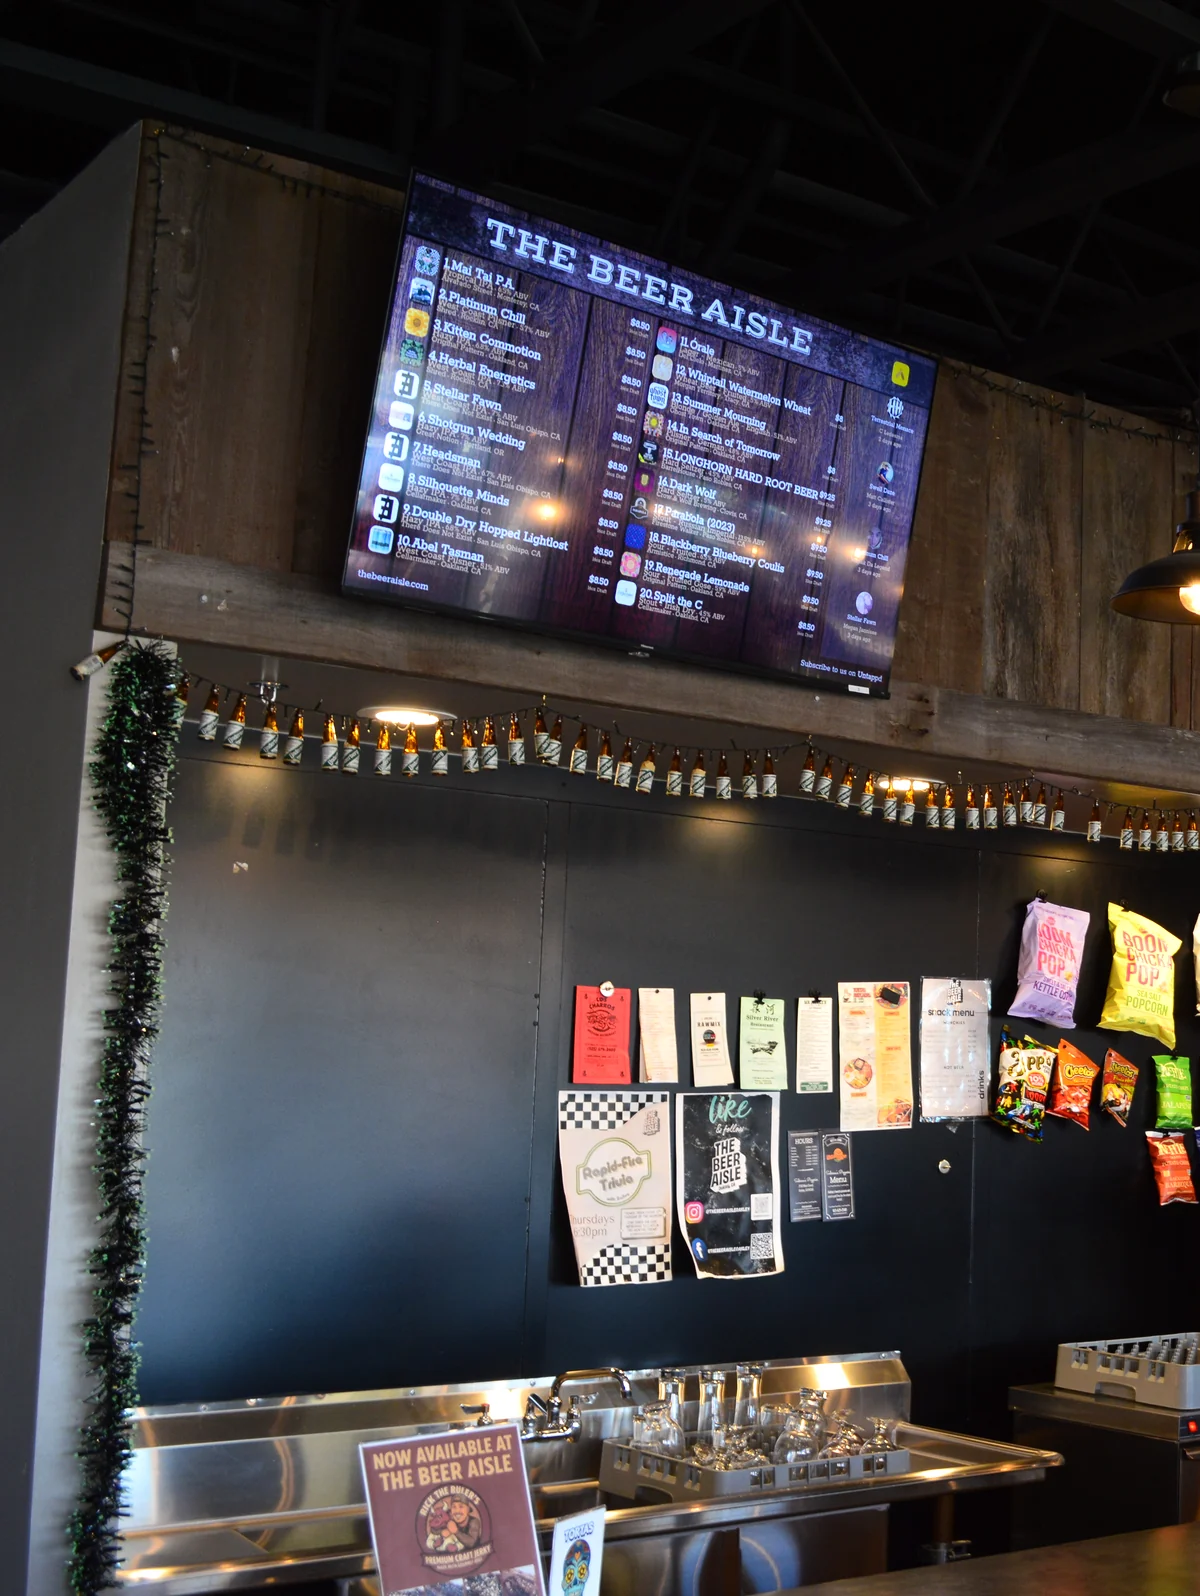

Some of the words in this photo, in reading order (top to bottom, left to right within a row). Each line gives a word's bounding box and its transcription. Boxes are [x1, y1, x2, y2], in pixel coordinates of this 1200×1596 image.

[475, 268, 491, 281] Tai
[486, 217, 576, 273] THE
[588, 254, 694, 313] BEER
[703, 295, 811, 353] AISLE
[501, 308, 525, 324] Chill
[630, 318, 649, 331] $8.50
[480, 333, 541, 360] Commotion
[477, 364, 535, 391] Energetics
[621, 375, 640, 387] $8.50
[472, 394, 501, 411] Fawn
[729, 381, 780, 405] Watermelon
[783, 398, 810, 414] Wheat
[724, 408, 765, 429] Mourning
[835, 414, 843, 422] $8
[477, 426, 525, 452] Wedding
[612, 432, 631, 444] $8.50
[691, 427, 721, 443] Search
[724, 436, 733, 447] of
[734, 440, 780, 460] Tomorrow
[827, 466, 835, 474] $8
[697, 486, 715, 499] Wolf
[735, 468, 762, 483] HARD
[765, 477, 791, 492] ROOT
[794, 485, 818, 499] BEER
[476, 489, 509, 506] Minds
[603, 489, 622, 501] $8.50
[423, 526, 439, 534] Does
[707, 517, 735, 533] (2023)
[454, 516, 475, 532] Dry
[478, 521, 520, 542] Hopped
[523, 531, 568, 553] Lightlost
[441, 544, 484, 562] Tasman
[593, 546, 613, 558] $8.50
[810, 543, 826, 553] $9.50
[712, 547, 755, 567] Blueberry
[758, 559, 784, 573] Coulis
[357, 568, 428, 591] thebeeraisle.com
[471, 567, 481, 575] CA
[806, 569, 822, 579] $9.50
[703, 574, 749, 592] Lemonade
[678, 596, 692, 607] the
[803, 595, 818, 605] $9.50
[798, 621, 814, 631] $8.50
[800, 659, 829, 671] Subscribe
[857, 671, 881, 683] Untappd
[1038, 938, 1077, 964] CHICKA
[1127, 947, 1173, 970] CHICKA
[1037, 950, 1066, 977] POP
[1125, 962, 1160, 987] POP
[1033, 980, 1058, 997] KETTLE
[1136, 989, 1149, 998] SEA
[1149, 993, 1161, 1001] SALT
[588, 1002, 616, 1011] CHARROS
[927, 1007, 951, 1017] snack
[951, 1009, 975, 1017] menu
[1126, 995, 1169, 1017] POPCORN
[746, 1014, 762, 1022] Silver
[763, 1014, 779, 1022] River
[708, 1094, 752, 1124] like
[722, 1123, 745, 1137] follow
[713, 1138, 736, 1158] THE
[794, 1137, 814, 1145] HOURS
[582, 1155, 644, 1181] Rapid-Fire
[712, 1151, 741, 1173] BEER
[599, 1173, 635, 1192] Trivia
[710, 1165, 742, 1188] AISLE
[829, 1176, 848, 1184] Menu
[373, 1448, 412, 1470] NOW
[416, 1438, 493, 1464] AVAILABLE
[496, 1434, 513, 1452] AT
[379, 1468, 415, 1492] THE
[418, 1461, 463, 1487] BEER
[467, 1454, 513, 1479] AISLE
[419, 1493, 436, 1517] RICK
[433, 1485, 449, 1499] THE
[450, 1485, 482, 1506] RULER'S
[563, 1521, 595, 1543] TORTAS
[425, 1553, 455, 1566] PREMIUM
[454, 1549, 473, 1563] CRAFT
[473, 1543, 491, 1558] JERKY
